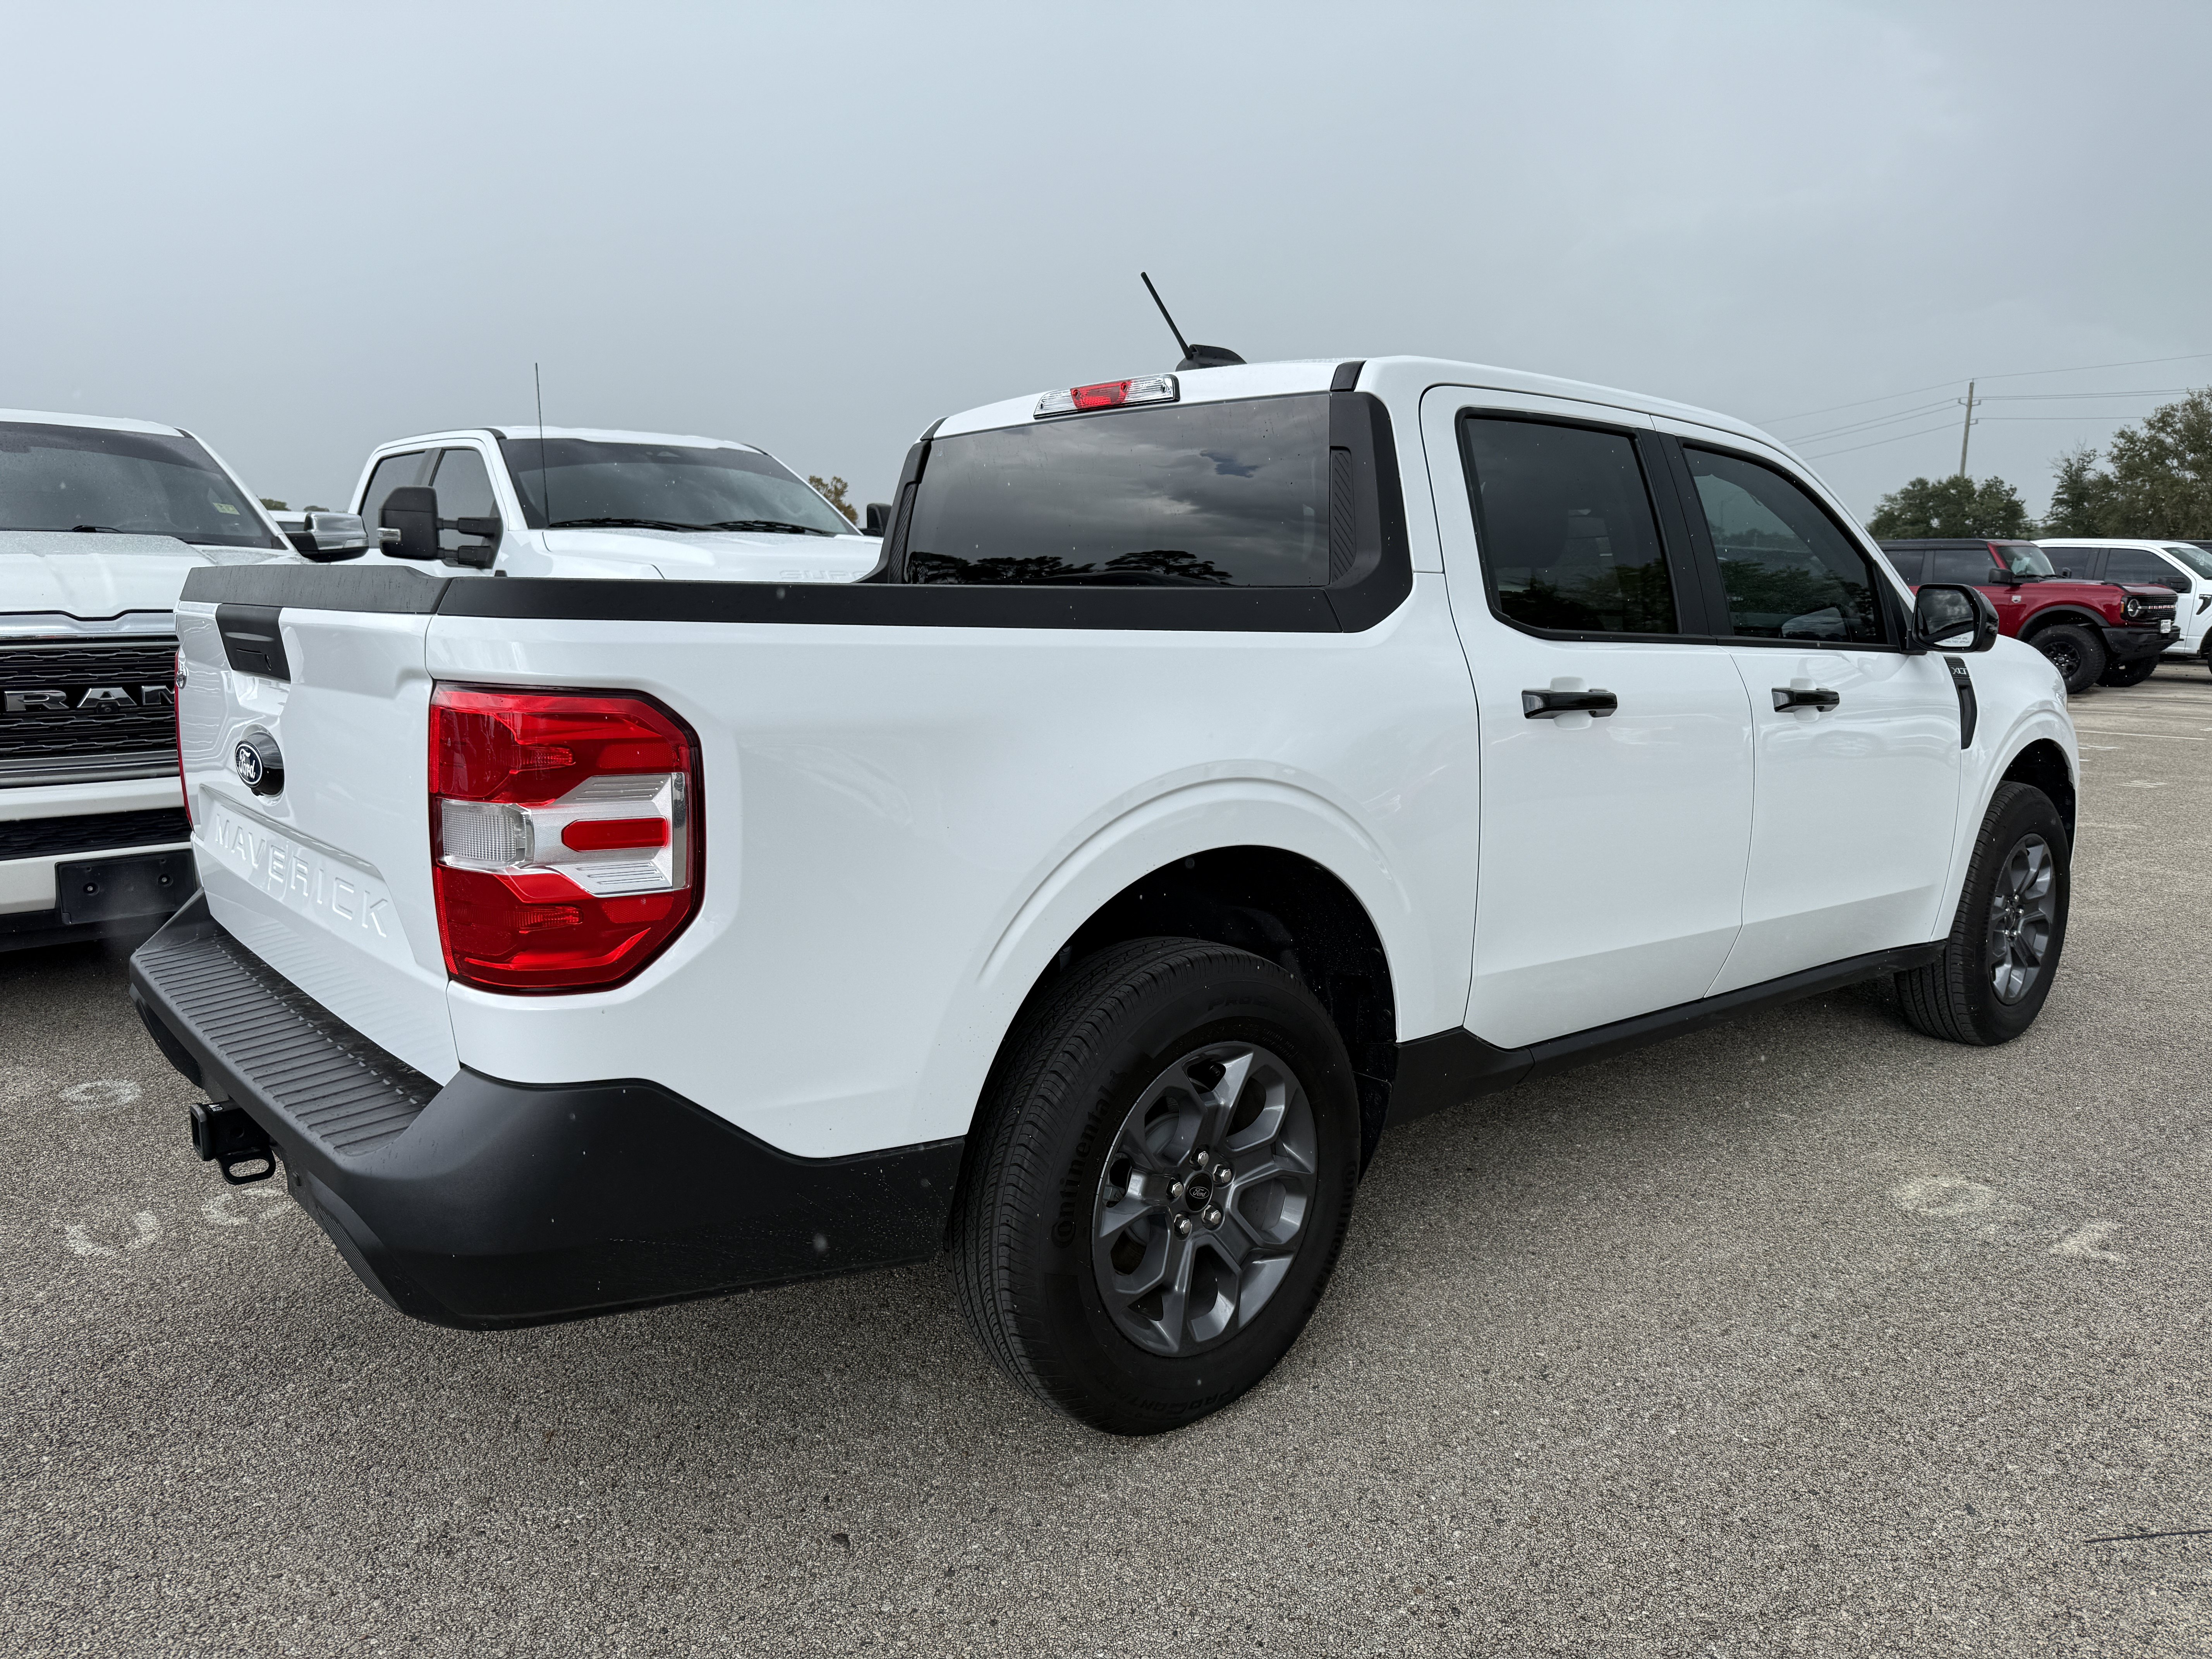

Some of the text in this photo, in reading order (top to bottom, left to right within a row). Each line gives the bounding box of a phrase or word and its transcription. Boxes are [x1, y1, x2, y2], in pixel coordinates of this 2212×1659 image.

[239, 748, 256, 779] Ford
[215, 813, 388, 938] MAVERICK
[1051, 1084, 1117, 1249] Continental
[1193, 1188, 1207, 1197] Ford
